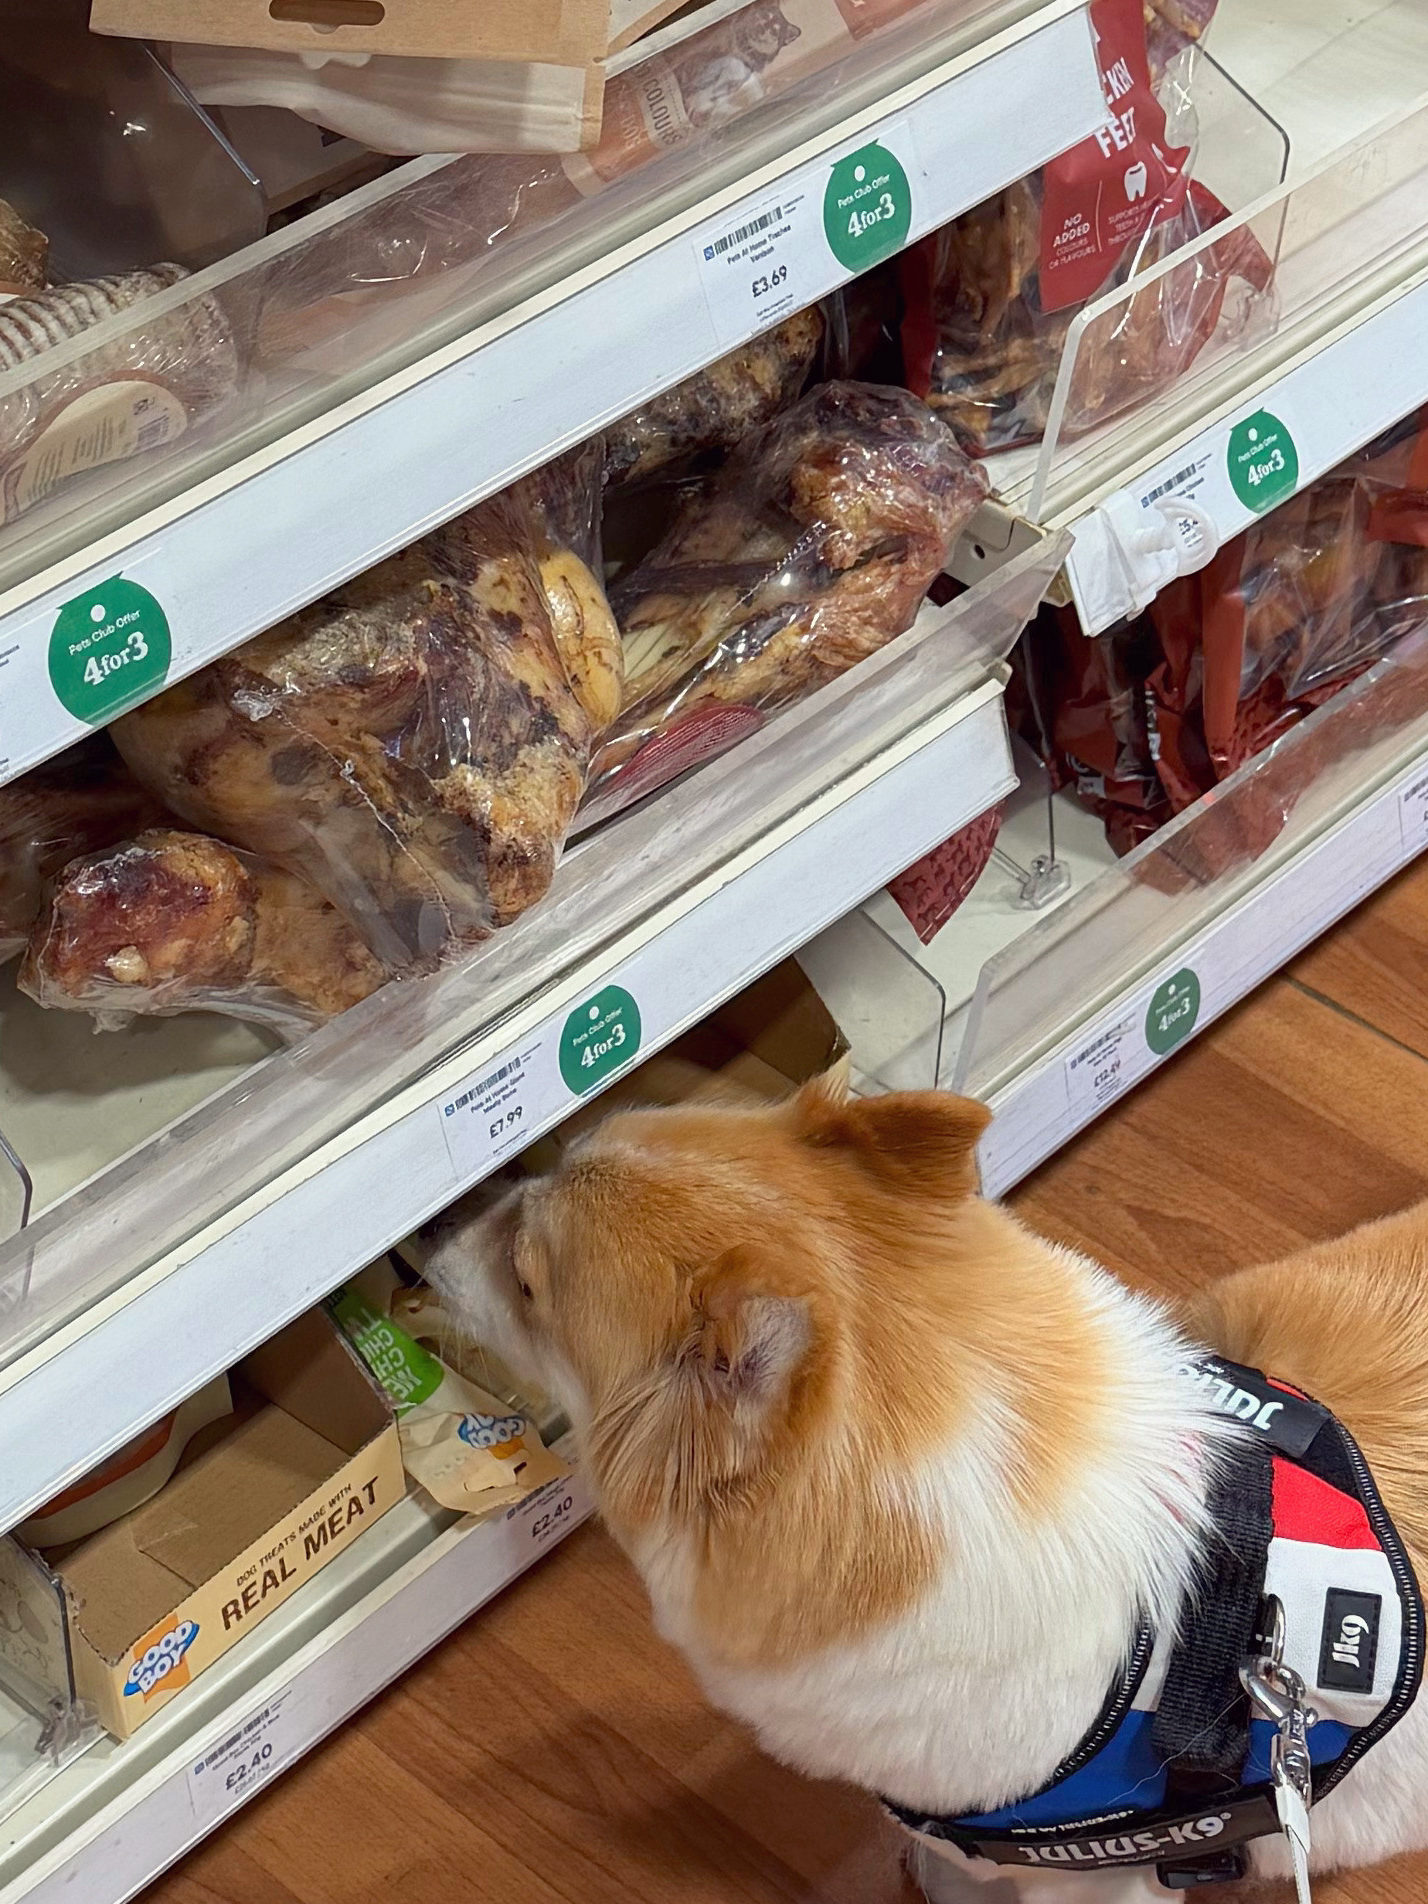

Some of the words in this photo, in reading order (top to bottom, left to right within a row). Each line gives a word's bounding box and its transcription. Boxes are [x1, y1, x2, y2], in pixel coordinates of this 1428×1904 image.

[848, 193, 895, 238] 4for3
[1053, 222, 1091, 248] ADDED
[1064, 213, 1082, 229] NO
[752, 265, 787, 297] £3.69
[68, 638, 92, 656] Pets
[92, 624, 115, 641] Club
[116, 609, 141, 628] Offer
[83, 631, 149, 686] 4for3
[580, 1023, 626, 1069] 4for3
[489, 1105, 523, 1139] £7.99
[236, 1564, 257, 1587] DOG
[259, 1531, 297, 1565] TREATS
[298, 1504, 327, 1534] MADE
[327, 1483, 352, 1507] WITH
[532, 1496, 573, 1537] £2.40
[220, 1557, 297, 1631] REAL
[303, 1476, 379, 1561] MEAT
[128, 1619, 193, 1684] GOOD
[137, 1646, 187, 1695] BOY
[226, 1743, 272, 1790] £2.40
